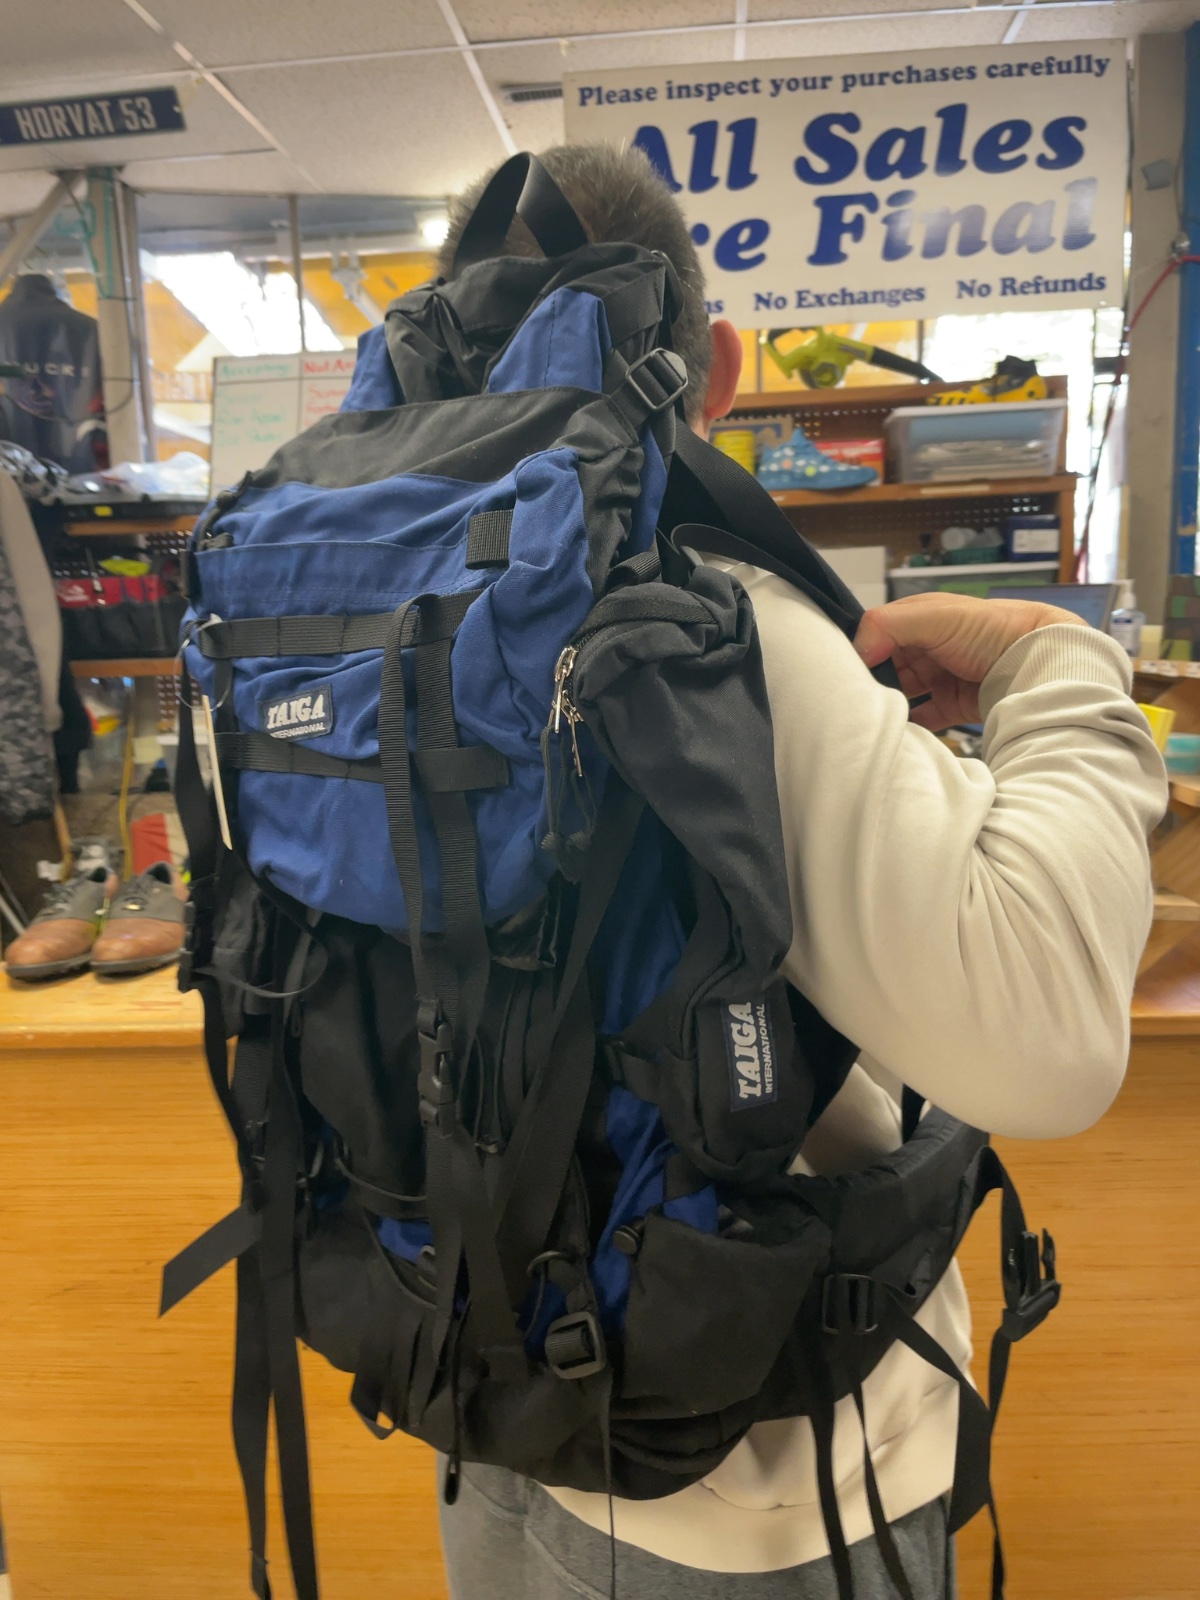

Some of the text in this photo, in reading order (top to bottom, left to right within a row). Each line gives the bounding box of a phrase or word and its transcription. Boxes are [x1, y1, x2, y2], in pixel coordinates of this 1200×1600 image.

[578, 54, 1111, 107] Please inspect your purchases carefully
[14, 96, 158, 140] HORVAT 53
[631, 103, 1087, 194] All Sales
[806, 176, 1098, 266] Final
[753, 291, 788, 311] No
[795, 285, 926, 308] Exchanges
[956, 279, 992, 299] No
[998, 272, 1107, 296] Refunds
[266, 694, 326, 730] TAIGA
[728, 1002, 762, 1099] TAIGA
[756, 1003, 773, 1094] INTERNATIONAL
